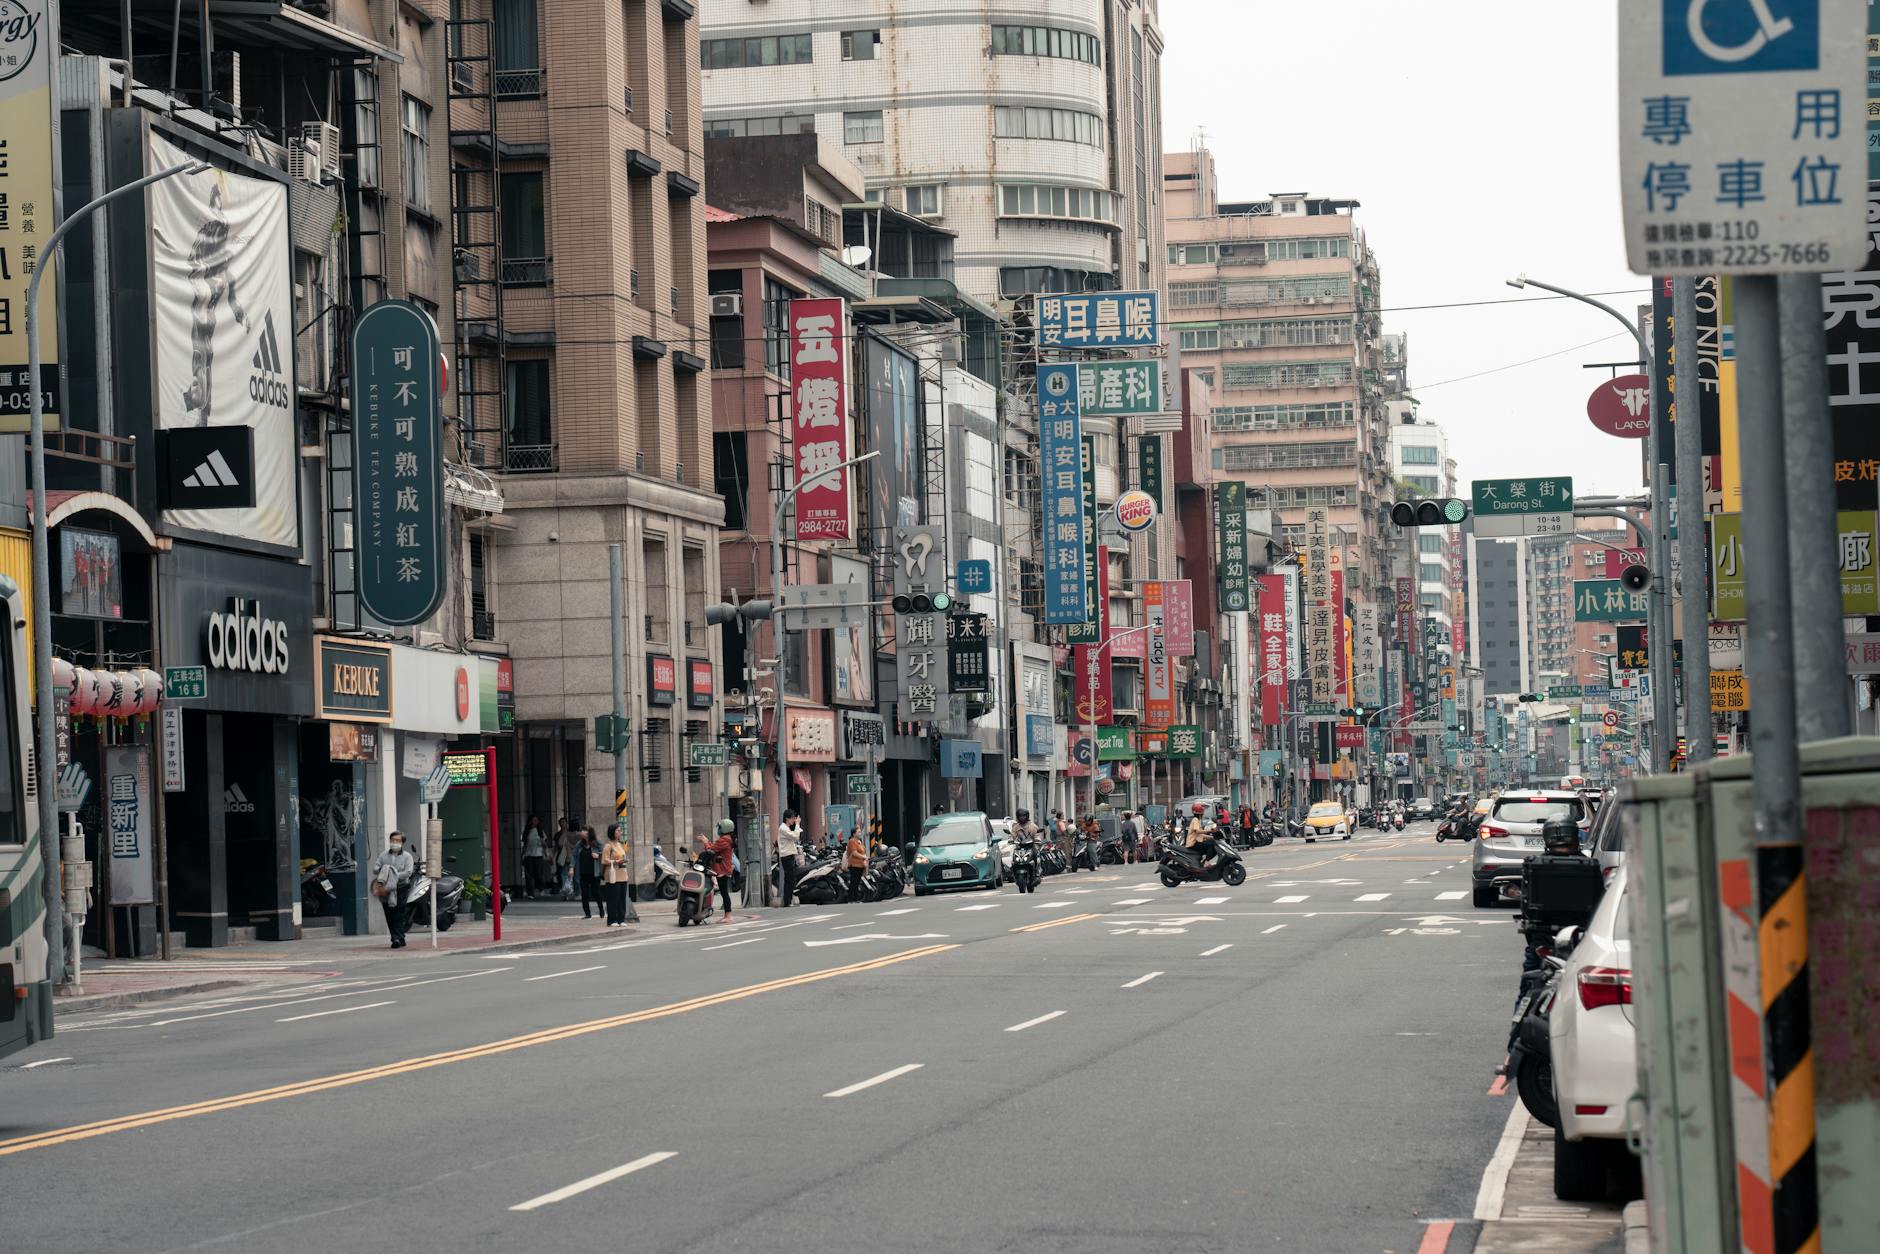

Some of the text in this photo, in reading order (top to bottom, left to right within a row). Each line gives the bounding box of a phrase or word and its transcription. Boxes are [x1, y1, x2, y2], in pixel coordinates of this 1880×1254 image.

[1642, 89, 1841, 146] 專用
[1642, 155, 1843, 213] 停車位
[22, 203, 35, 232] 營養
[22, 245, 36, 275] 美味
[1043, 298, 1153, 345] 明安 耳鼻喉
[249, 370, 288, 410] adidas
[369, 384, 379, 440] KEBUKE
[392, 346, 422, 583] 可不可熟成紅茶
[1054, 420, 1079, 569] 明安耳鼻喉科
[1481, 481, 1556, 500] 大榮街
[1493, 499, 1545, 511] Darong St.
[1119, 499, 1151, 513] BURGER
[1120, 505, 1152, 523] KING
[1536, 515, 1561, 524] 10-48
[799, 520, 847, 533] 2984-2727
[1537, 524, 1561, 533] 23-49
[1308, 510, 1327, 597] 美上美醫學美容
[1399, 581, 1410, 603] 英文
[208, 597, 289, 674] adidas
[905, 583, 936, 714] 輝牙醫
[1263, 612, 1283, 686] 鞋全家福
[1313, 609, 1331, 697] 達昇皮膚科
[178, 684, 189, 696] 16
[333, 663, 380, 697] KEBUKE
[1154, 666, 1165, 690] KTV
[1711, 691, 1744, 708] 電腦
[56, 699, 69, 766] 小陳食堂
[1173, 729, 1197, 754] 藥
[700, 756, 712, 764] 28
[856, 784, 867, 792] 36
[110, 774, 140, 858] 重新里
